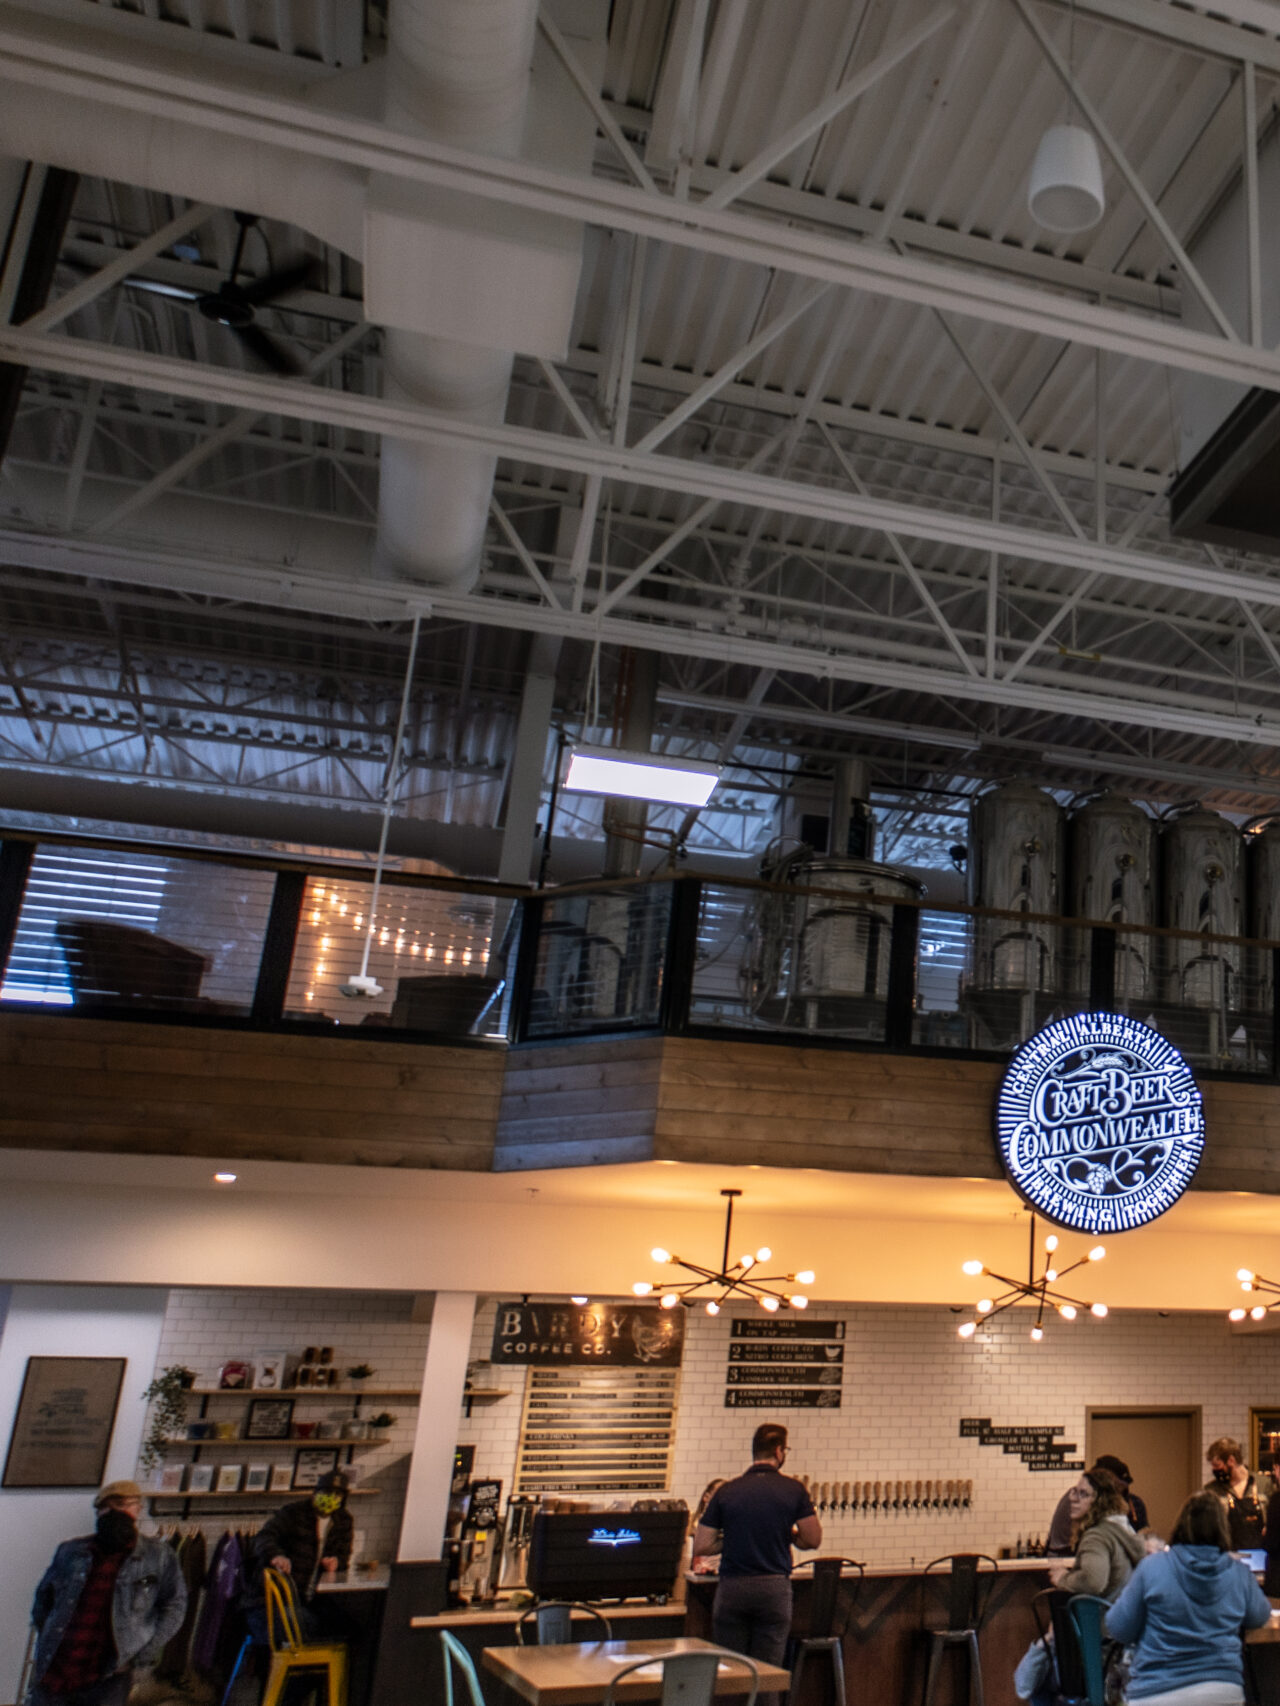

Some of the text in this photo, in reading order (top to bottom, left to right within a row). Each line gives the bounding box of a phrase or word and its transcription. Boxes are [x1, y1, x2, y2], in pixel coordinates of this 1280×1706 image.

[1012, 1021, 1152, 1095] CENTRAL ALBERTA
[1036, 1068, 1191, 1127] CRAFT BEER
[1009, 1107, 1201, 1175] COMMONWEALTH
[1031, 1149, 1193, 1223] BREWING TOGETHER
[502, 1342, 612, 1355] COFFEE CO.
[740, 1367, 807, 1375] COMMONWEALTH
